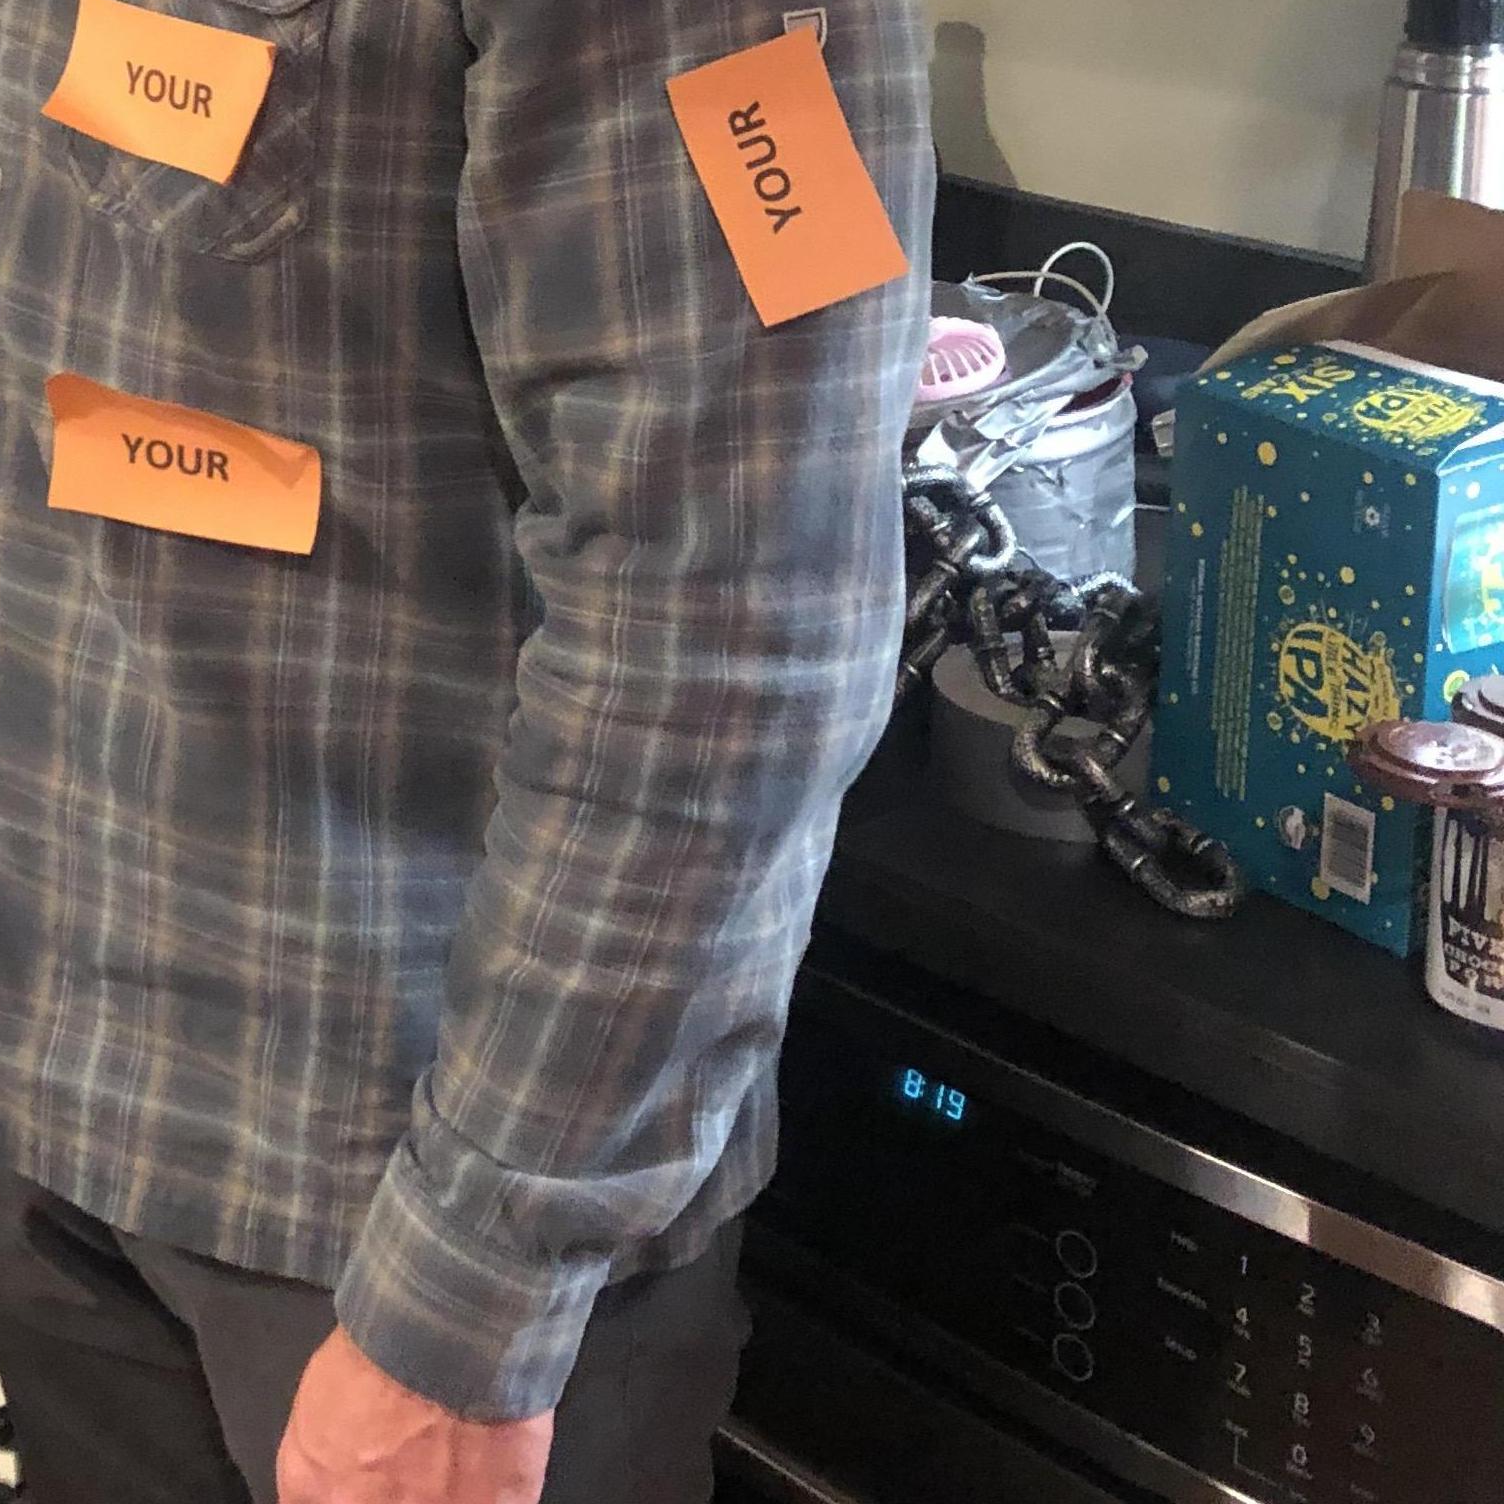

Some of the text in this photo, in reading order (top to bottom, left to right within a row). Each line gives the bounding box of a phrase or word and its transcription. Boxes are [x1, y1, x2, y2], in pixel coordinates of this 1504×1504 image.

[126, 61, 213, 118] YOUR
[728, 101, 802, 234] YOUR
[121, 433, 229, 482] YOUR
[904, 1068, 965, 1120] 8:19
[1235, 1306, 1249, 1325] 4
[1234, 1361, 1247, 1382] 7
